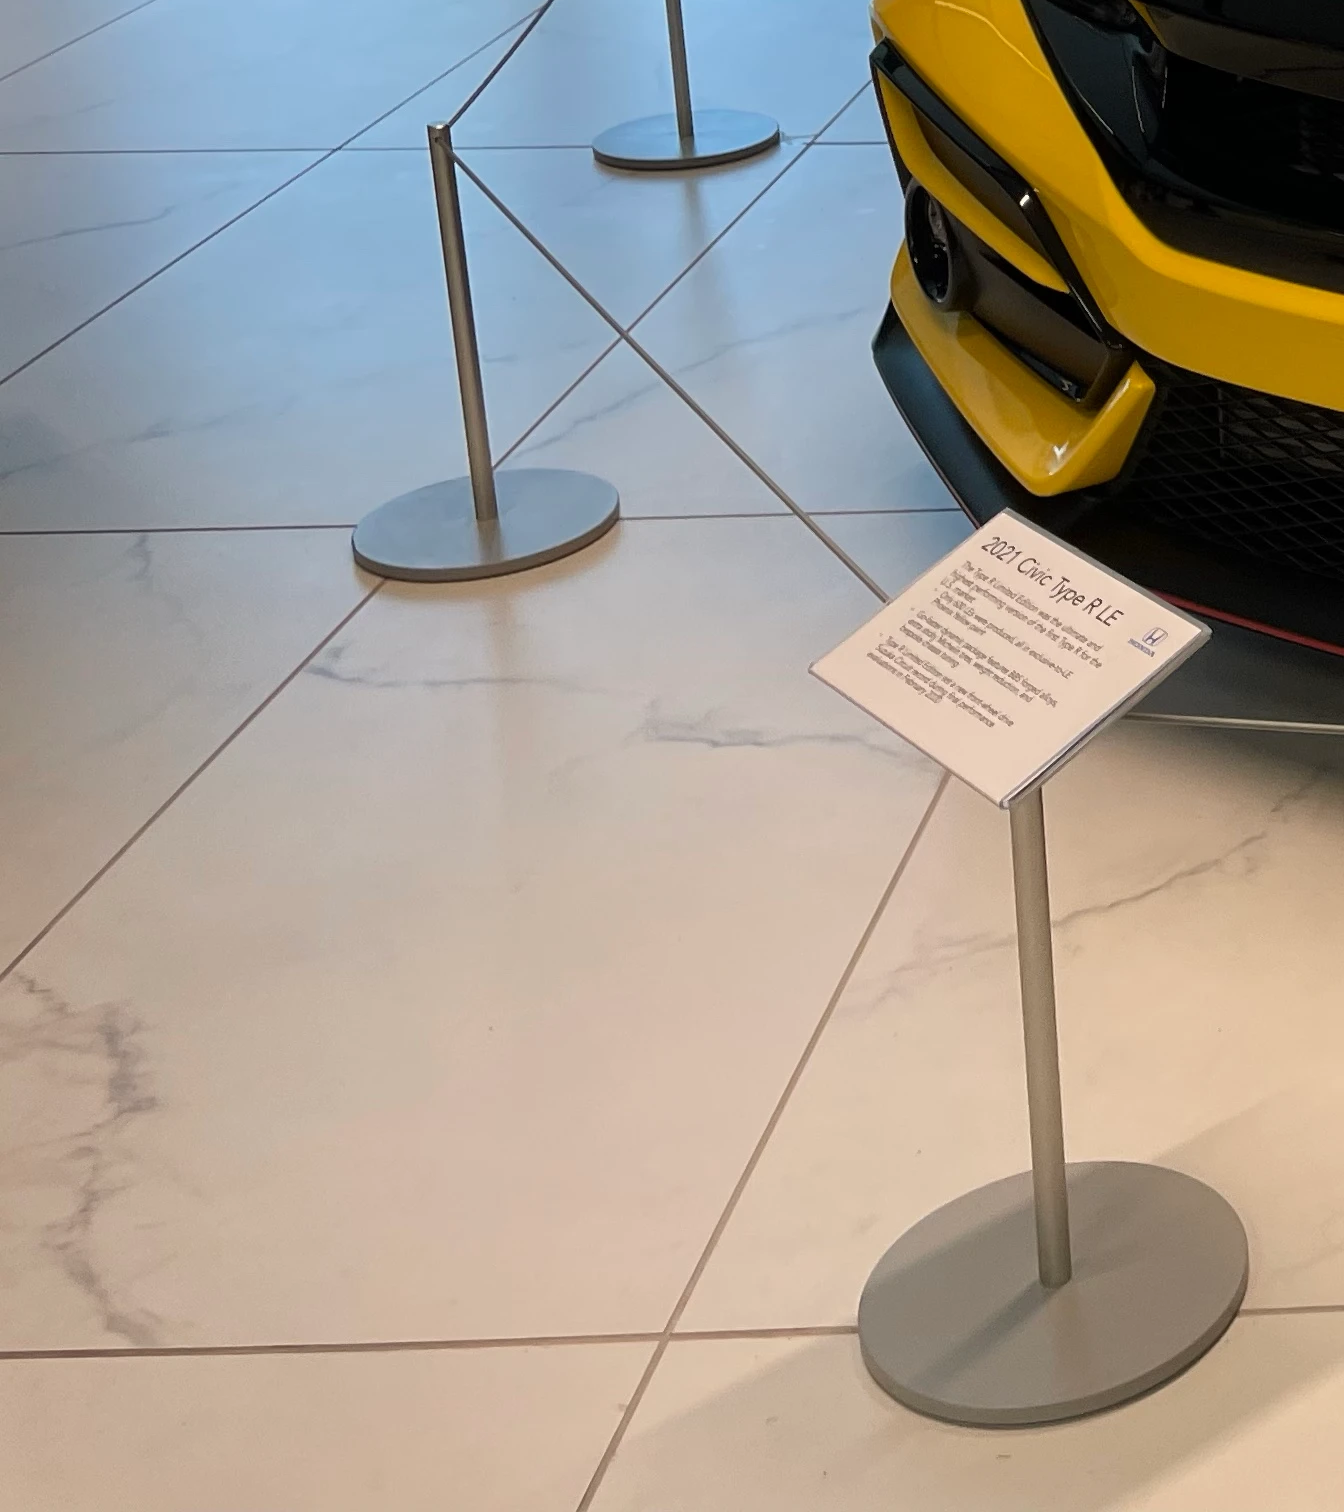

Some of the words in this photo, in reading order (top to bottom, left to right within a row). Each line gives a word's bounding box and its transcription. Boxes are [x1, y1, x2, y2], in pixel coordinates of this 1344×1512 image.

[980, 536, 1022, 564] 2021
[1017, 557, 1053, 586] Civic
[1050, 576, 1085, 606] Type
[1082, 597, 1103, 615] R
[1095, 605, 1124, 627] LE
